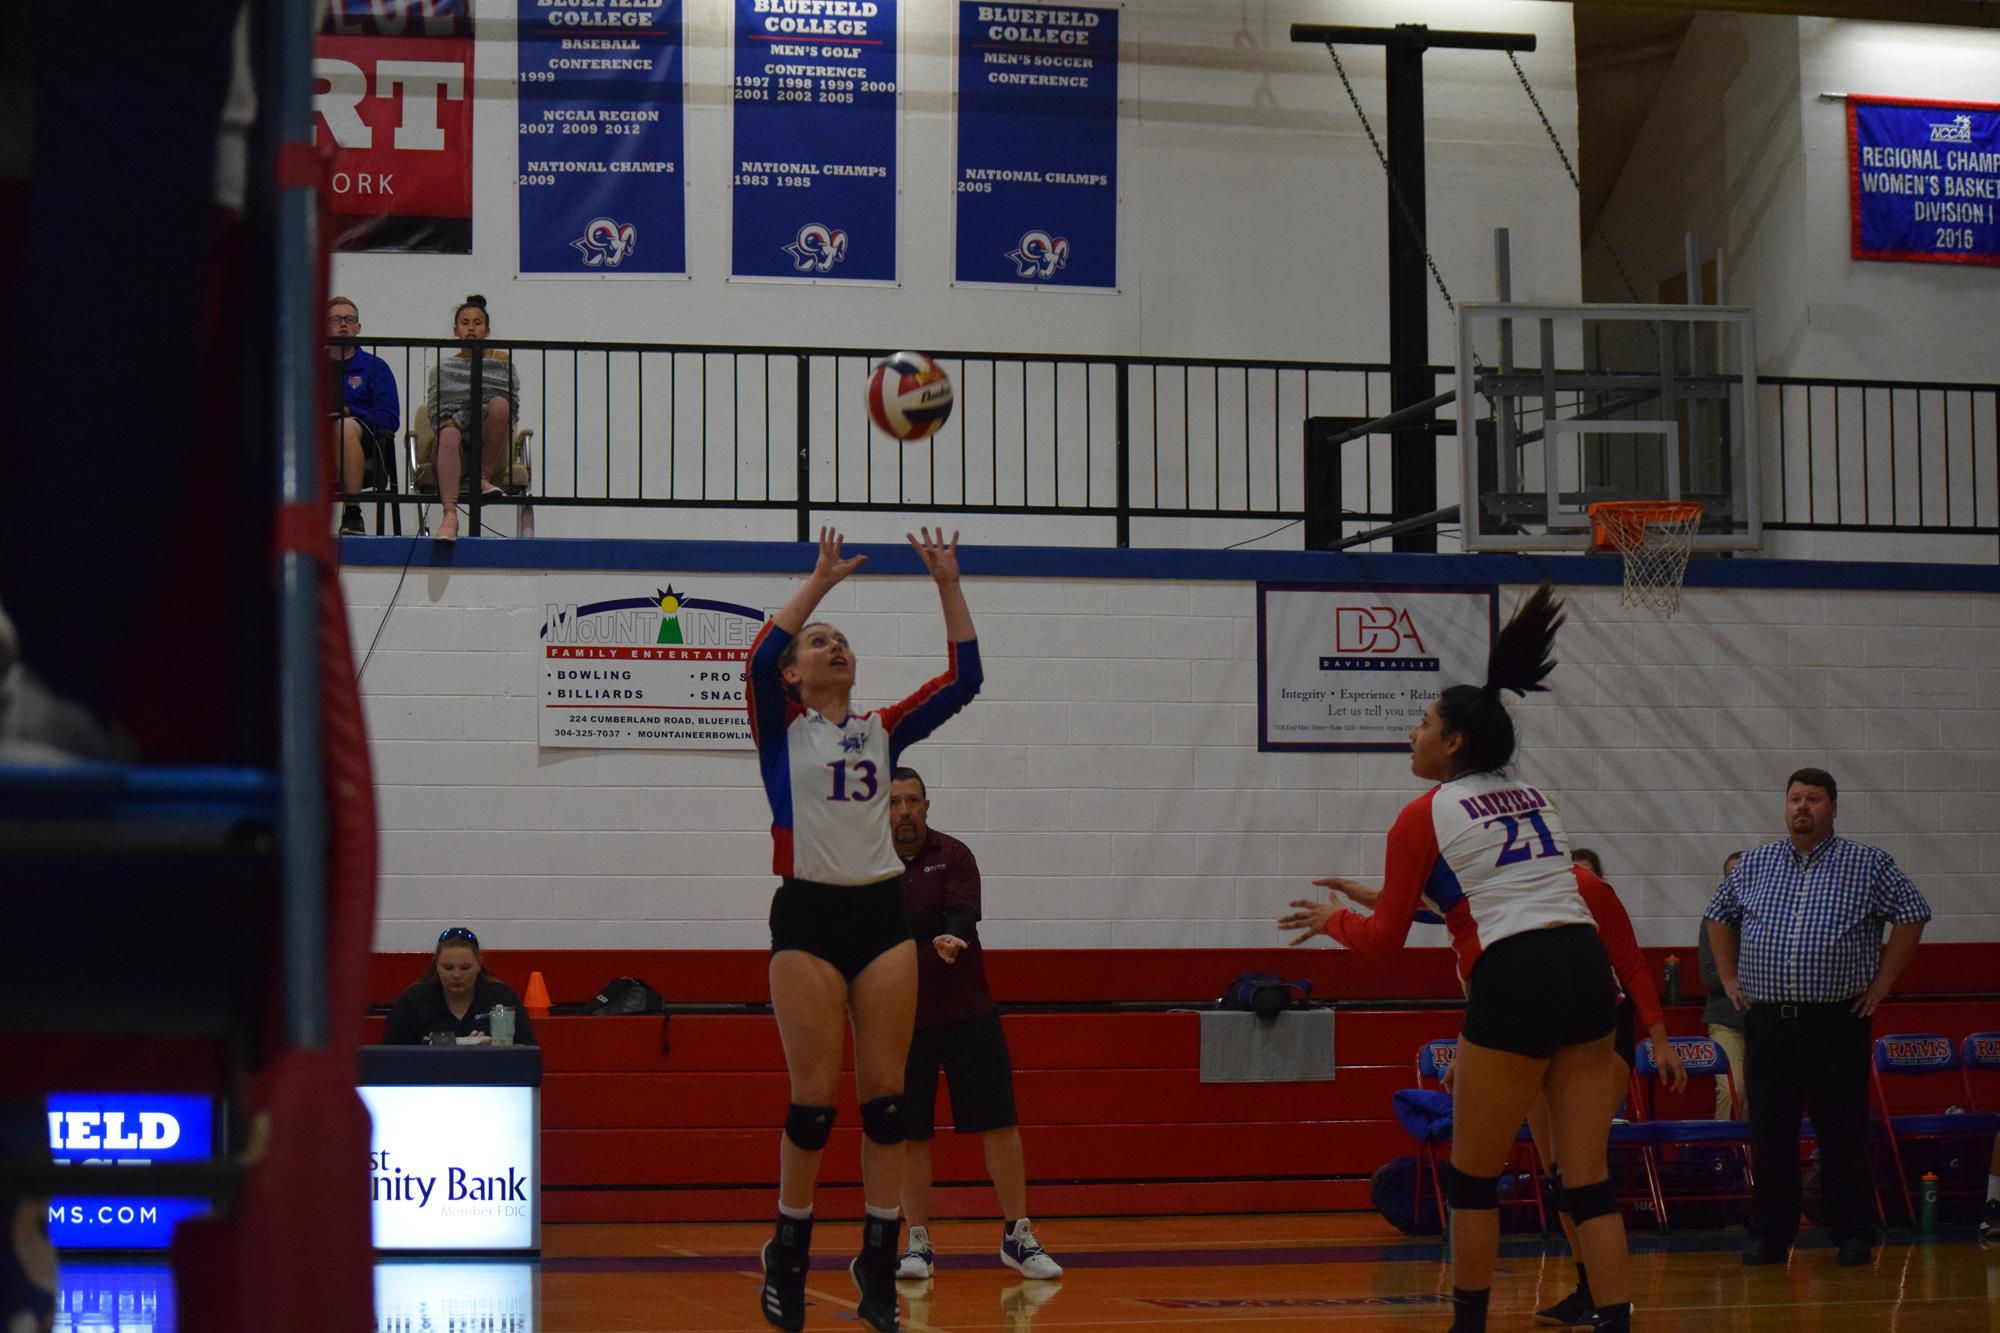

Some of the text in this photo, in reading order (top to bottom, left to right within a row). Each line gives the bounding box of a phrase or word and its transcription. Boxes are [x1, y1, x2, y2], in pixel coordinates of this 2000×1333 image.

[754, 0, 878, 18] BLUEFIELD
[548, 11, 653, 27] COLLEGE
[978, 8, 1100, 28] BLUEFIELD
[764, 17, 867, 36] COLLEGE
[988, 26, 1089, 46] COLLEGE
[561, 39, 640, 50] BASEBALL
[770, 44, 862, 59] MEN'S GOLF
[549, 58, 652, 70] CONFERENCE
[984, 52, 1093, 69] MEN'S SOCCER
[520, 72, 555, 82] 1999
[764, 63, 867, 78] CONFERENCE
[735, 76, 895, 93] 1997 1998 1999 2000
[988, 72, 1089, 88] CONFERENCE
[734, 90, 854, 103] 2001 2002 2005
[543, 110, 659, 122] NCCAA REGION
[520, 124, 640, 135] 2007 2009 2012
[1930, 127, 1971, 139] NCCAA
[1863, 147, 1942, 170] REGIONAL
[527, 162, 674, 173] NATIONAL CHAMPS
[742, 162, 887, 177] NATIONAL CHAMPS
[520, 175, 555, 185] 2009
[734, 175, 811, 188] 1983 1985
[966, 168, 1107, 186] NATIONAL CHAMPS
[1862, 172, 1940, 197] WOMEN'S
[958, 182, 992, 193] 2005
[1915, 201, 1993, 224] DIVISION I
[1936, 228, 1973, 249] 2016
[1336, 607, 1426, 653] DBA
[552, 649, 617, 658] FAMILY
[557, 671, 632, 680] BOWLING
[700, 672, 731, 681] PRO
[557, 690, 644, 699] BILLIARDS
[1282, 688, 1326, 701] Integrity
[1340, 689, 1396, 702] Experience
[1328, 705, 1348, 716] Let
[1351, 708, 1362, 716] us
[1365, 705, 1382, 716] tell
[1384, 709, 1404, 720] you
[569, 715, 587, 723] 224
[590, 716, 661, 724] CUMBERLAND
[664, 717, 695, 726] ROAD,
[555, 729, 620, 737] 304-325-7037
[827, 759, 878, 802] 13
[1482, 809, 1564, 868] 21
[1888, 1039, 1949, 1057] RAMS
[448, 1166, 528, 1201] Bank
[498, 1206, 528, 1217] FDIC
